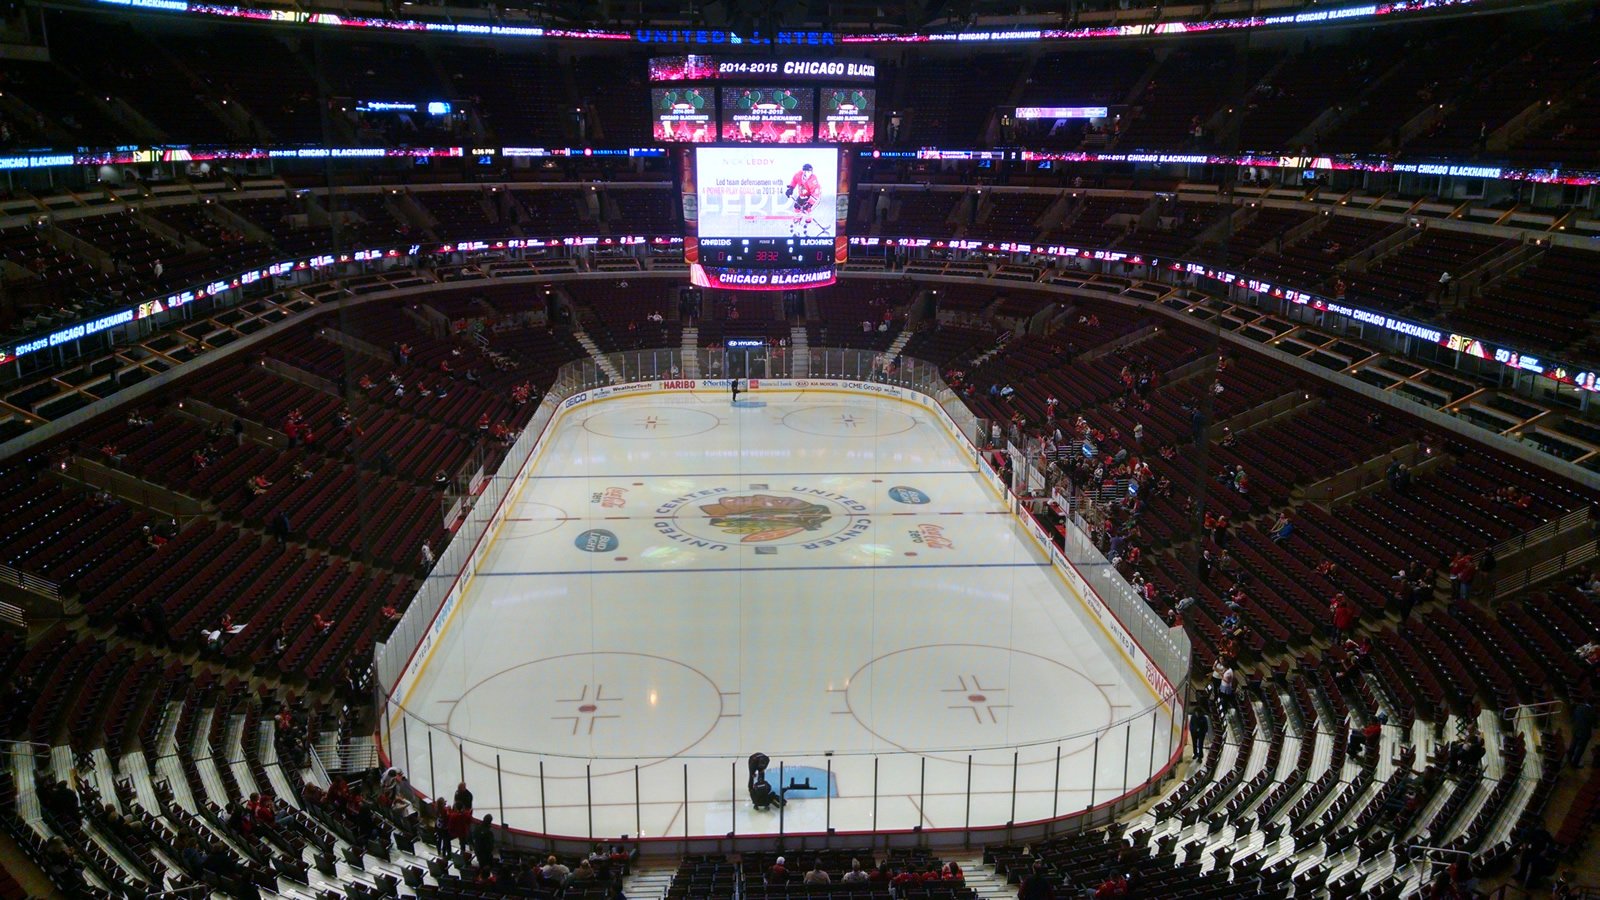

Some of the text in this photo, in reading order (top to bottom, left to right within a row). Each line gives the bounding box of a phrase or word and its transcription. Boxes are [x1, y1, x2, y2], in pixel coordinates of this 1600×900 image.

[1264, 6, 1376, 24] 2014-2015 CHICAGO BLACKHAWKS
[457, 25, 490, 33] CHICAGO
[492, 27, 543, 35] BLACKHAWKS
[637, 30, 725, 43] UNITED
[991, 31, 1041, 39] BLACKHAWKS
[719, 63, 778, 73] 2014-2015
[783, 61, 844, 75] CHICAGO
[298, 149, 329, 157] CHICAGO
[331, 148, 385, 156] BLACKHAWKS
[1127, 154, 1157, 162] CHICAGO
[1158, 154, 1208, 163] BLACKHAWKS
[0, 155, 74, 168] CHICAGO BLACKHAWKS
[1393, 164, 1501, 178] 2014-2015 CHICAGO BLACKHAWKS
[719, 270, 831, 284] CHICAGO BLACKHAWKS
[1249, 280, 1255, 289] 11
[1285, 290, 1294, 300] 27
[1327, 303, 1441, 343] 2014-2015 CHICAGO BLACKHAWKS
[15, 309, 133, 356] 2014-2015 CHICAGO BLACKHAWKS
[1495, 348, 1509, 363] 50
[664, 381, 695, 389] HARIBO
[1575, 372, 1585, 385] 4
[613, 383, 652, 391] WeatherTech
[863, 384, 882, 393] Group
[656, 486, 729, 514] CENTER
[792, 486, 872, 550] UNITED CENTER
[586, 532, 610, 552] BUD LIGHT
[654, 521, 728, 552] UNITED
[908, 530, 924, 543] zero
[1110, 621, 1129, 648] UNITED
